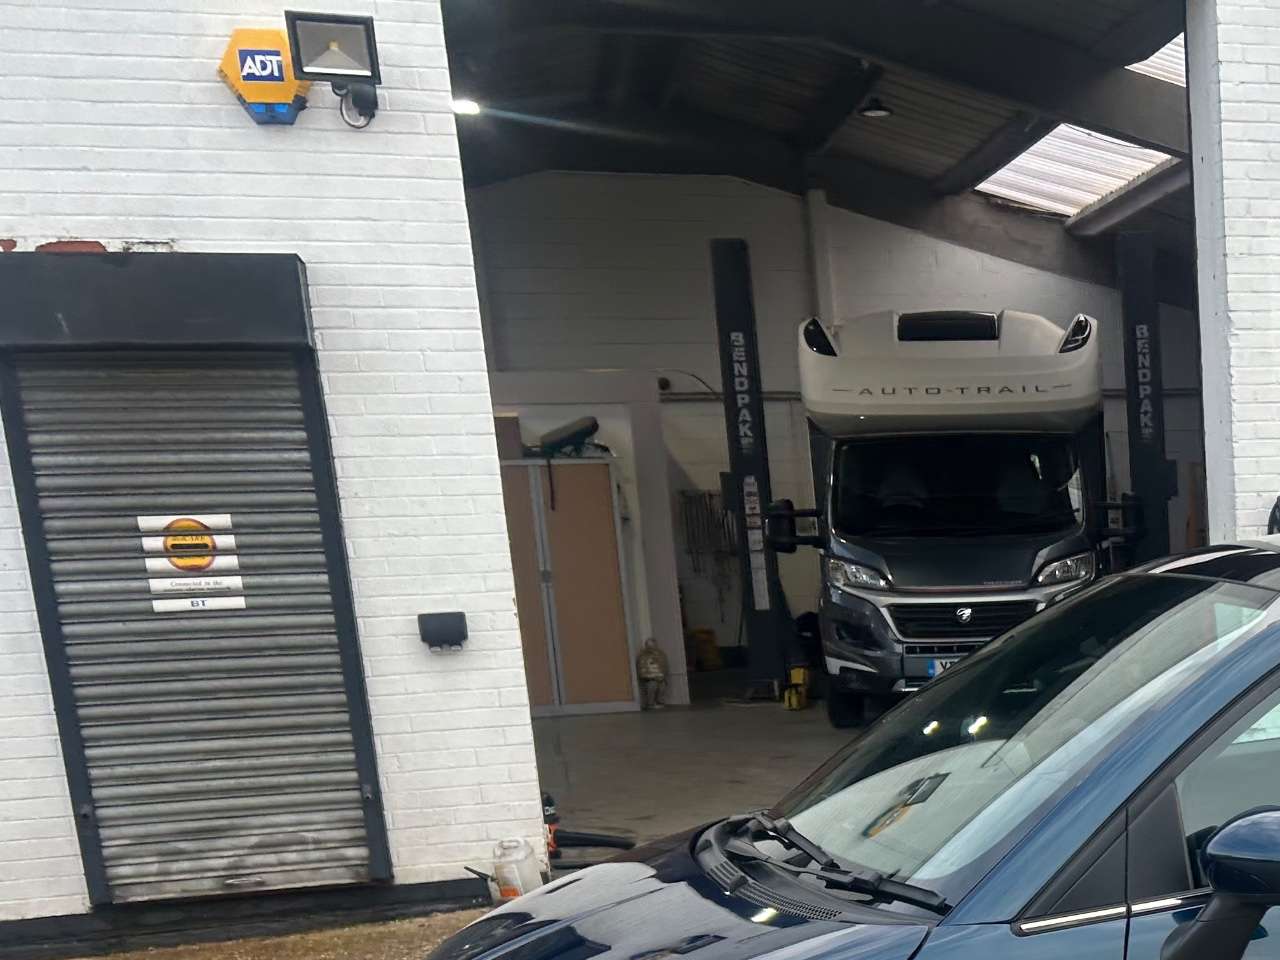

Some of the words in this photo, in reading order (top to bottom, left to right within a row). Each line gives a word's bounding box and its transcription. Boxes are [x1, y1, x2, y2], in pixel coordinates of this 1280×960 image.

[241, 54, 282, 77] ADT
[730, 331, 753, 437] BENDPAK
[858, 384, 1049, 396] AUTO-TRAIL
[1135, 324, 1153, 427] BENDPAK
